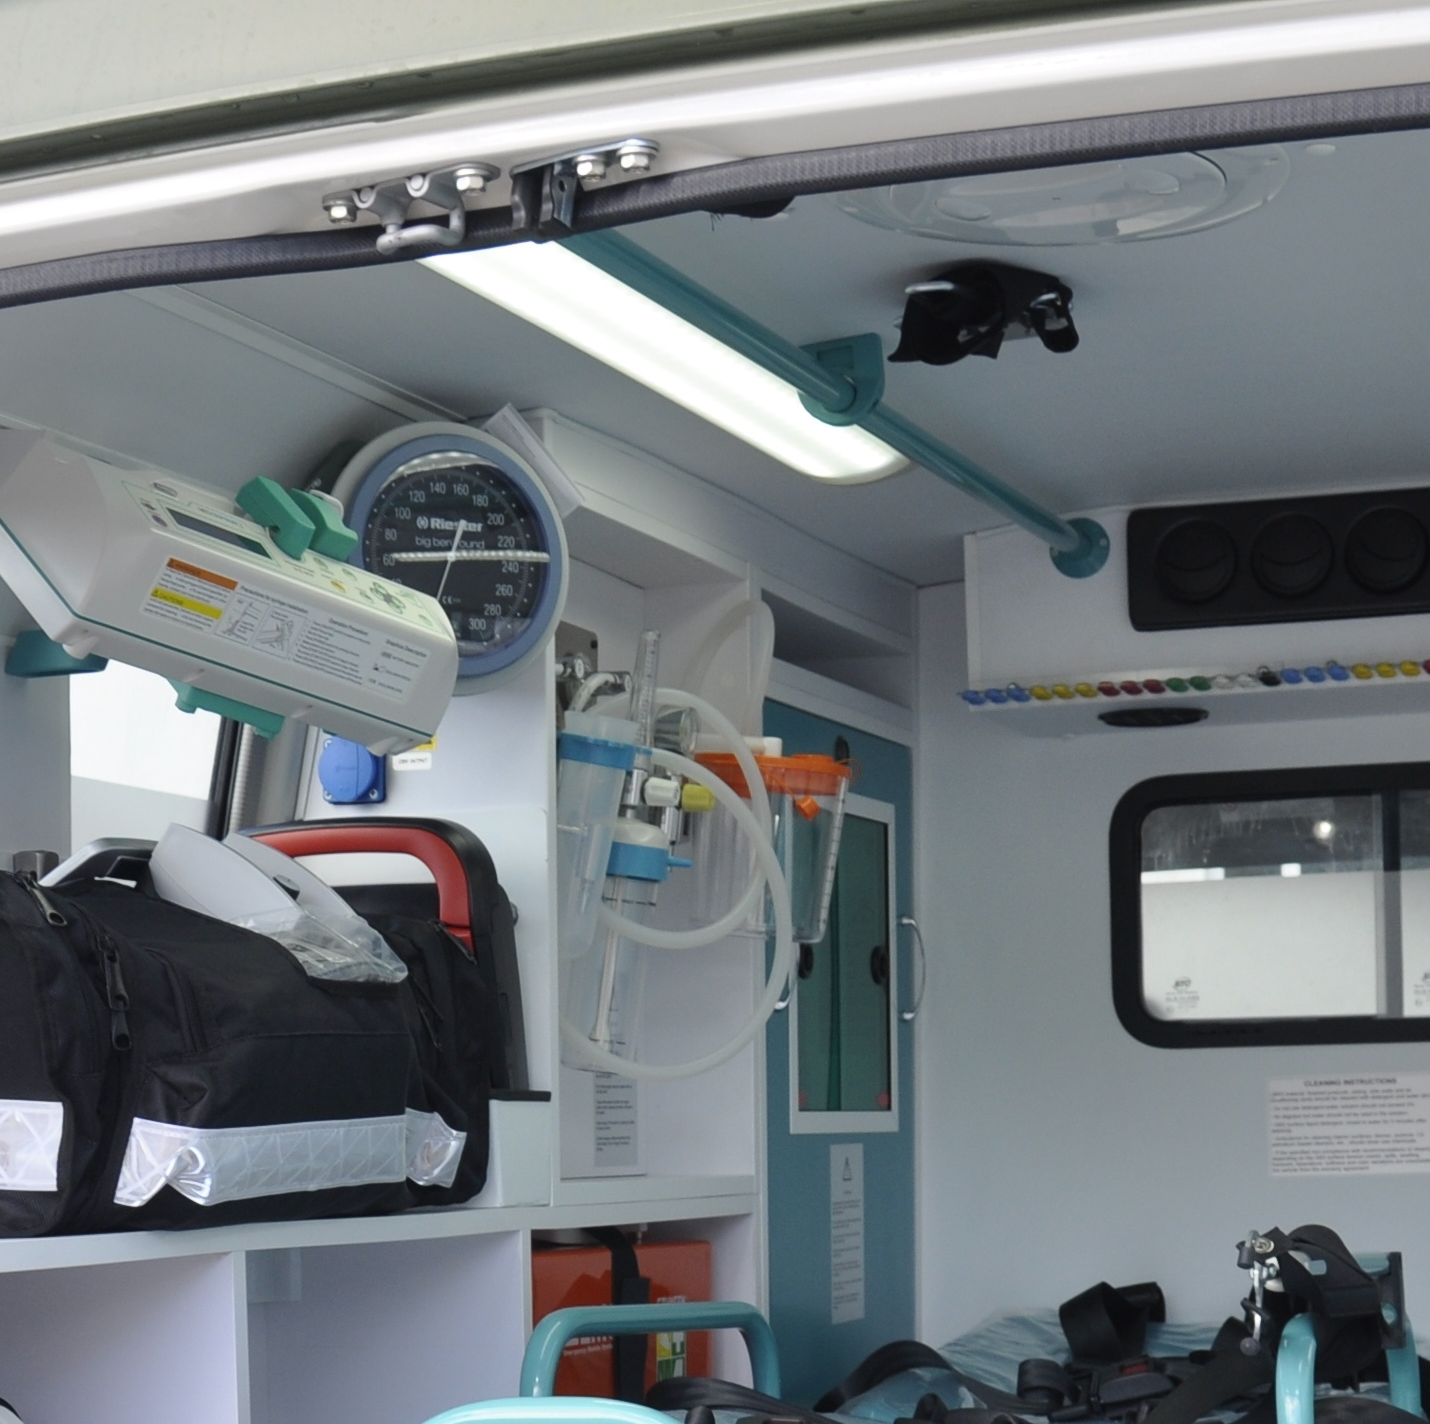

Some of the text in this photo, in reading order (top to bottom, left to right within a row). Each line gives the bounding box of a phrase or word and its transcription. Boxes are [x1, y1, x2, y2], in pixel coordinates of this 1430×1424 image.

[429, 482, 446, 494] 140
[453, 484, 469, 496] 160
[409, 491, 425, 502] 120
[472, 495, 488, 507] 180
[394, 507, 411, 519] 100
[487, 513, 504, 525] 200
[384, 528, 397, 540] 80
[415, 536, 431, 548] big
[433, 537, 452, 547] ben
[497, 536, 515, 548] 220
[383, 554, 395, 566] 60
[501, 561, 519, 573] 240
[495, 584, 513, 596] 260
[484, 604, 501, 616] 280
[468, 618, 486, 630] 300
